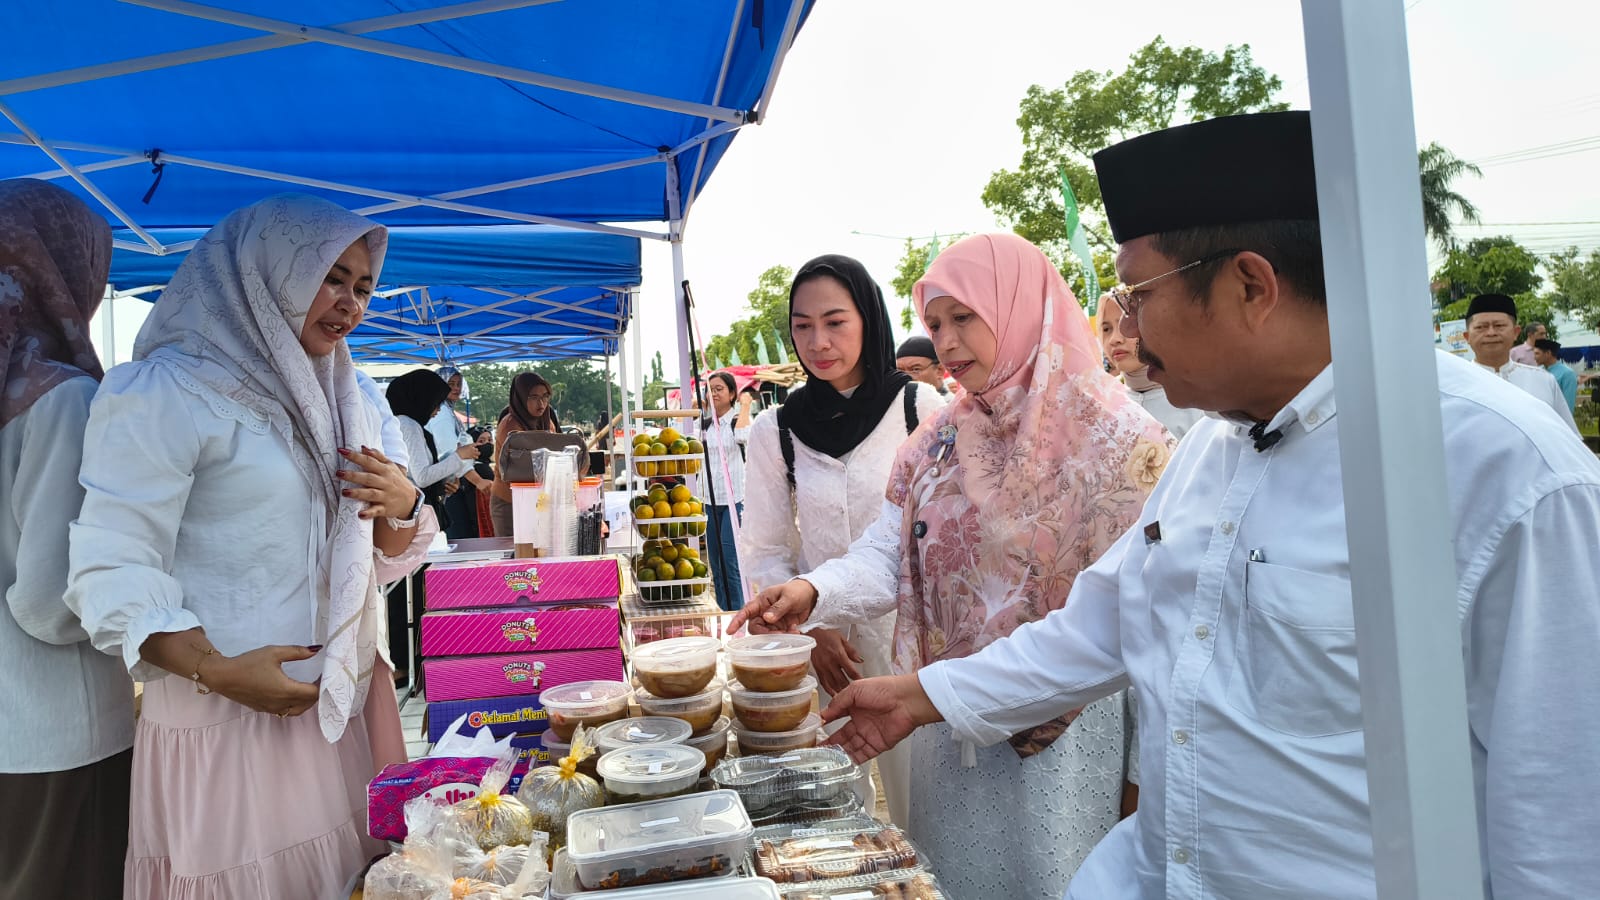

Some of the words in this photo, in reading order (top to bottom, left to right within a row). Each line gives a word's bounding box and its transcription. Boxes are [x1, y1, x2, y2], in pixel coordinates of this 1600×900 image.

[503, 570, 532, 581] DONUTS
[501, 621, 530, 631] DONUTS
[502, 662, 531, 672] DONUTS
[482, 710, 520, 724] Selamat
